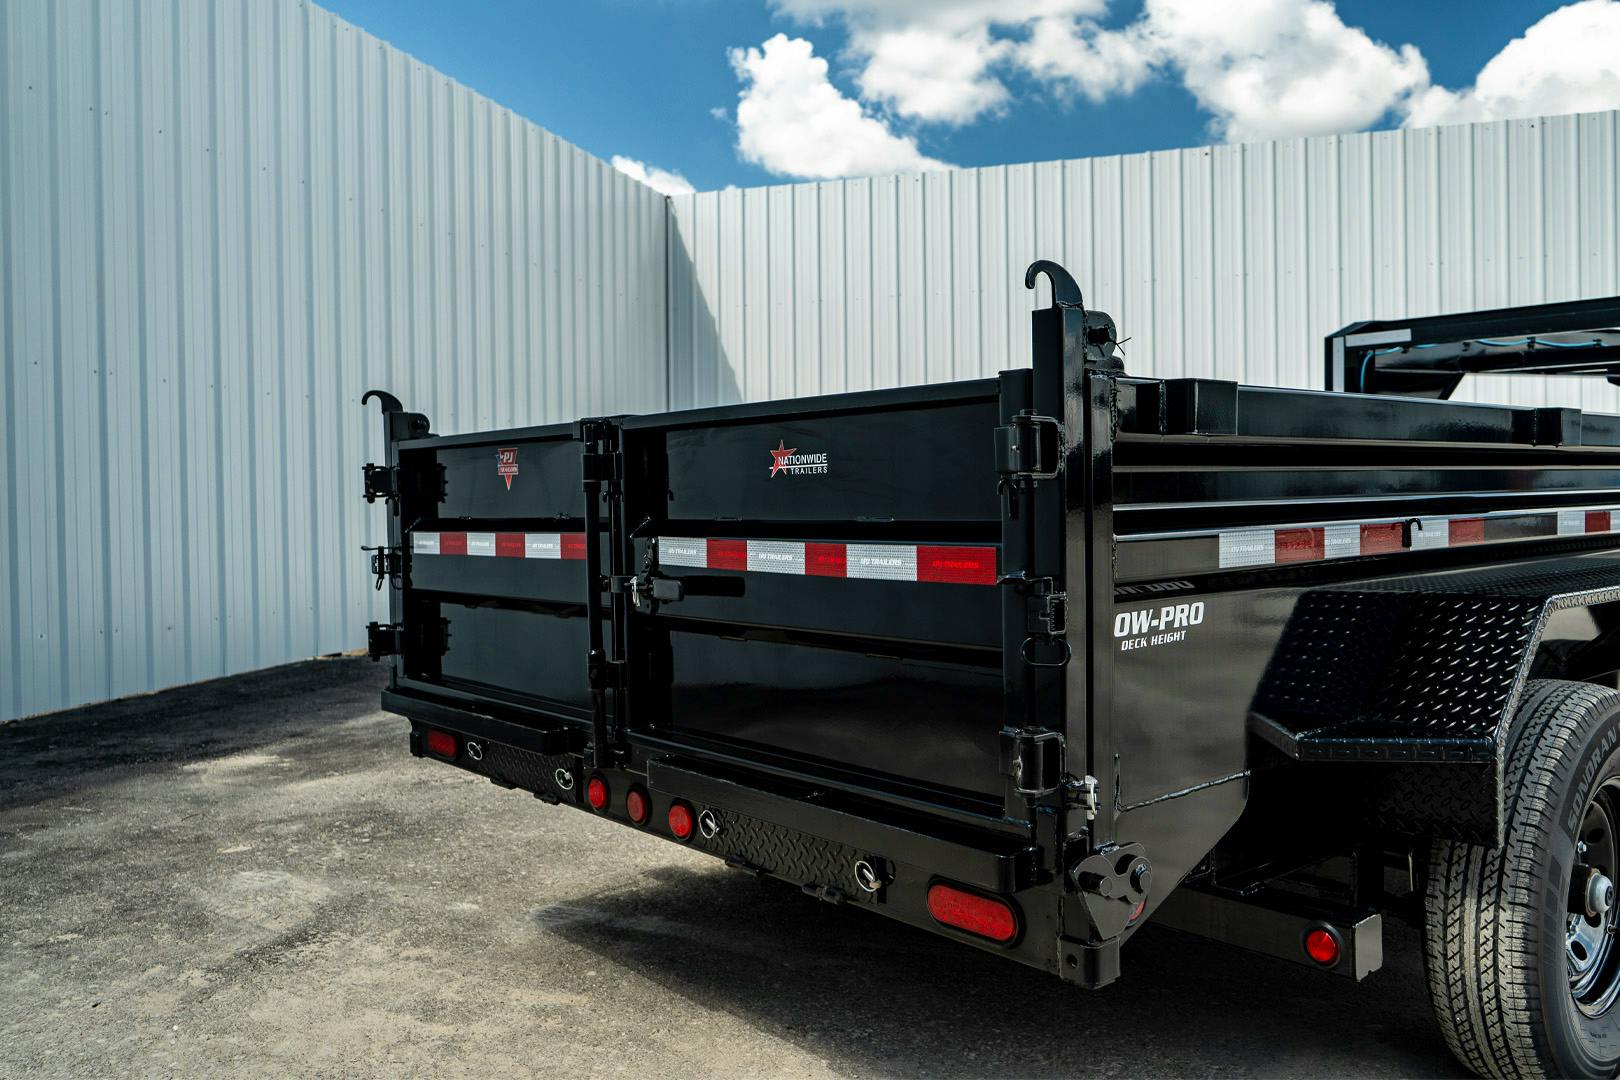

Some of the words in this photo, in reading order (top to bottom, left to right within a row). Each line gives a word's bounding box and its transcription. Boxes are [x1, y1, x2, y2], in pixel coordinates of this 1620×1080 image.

[778, 453, 828, 465] NATIONWIDE
[790, 466, 828, 475] TRAILERS
[1121, 637, 1148, 651] DECK
[1151, 630, 1187, 646] HEIGHT
